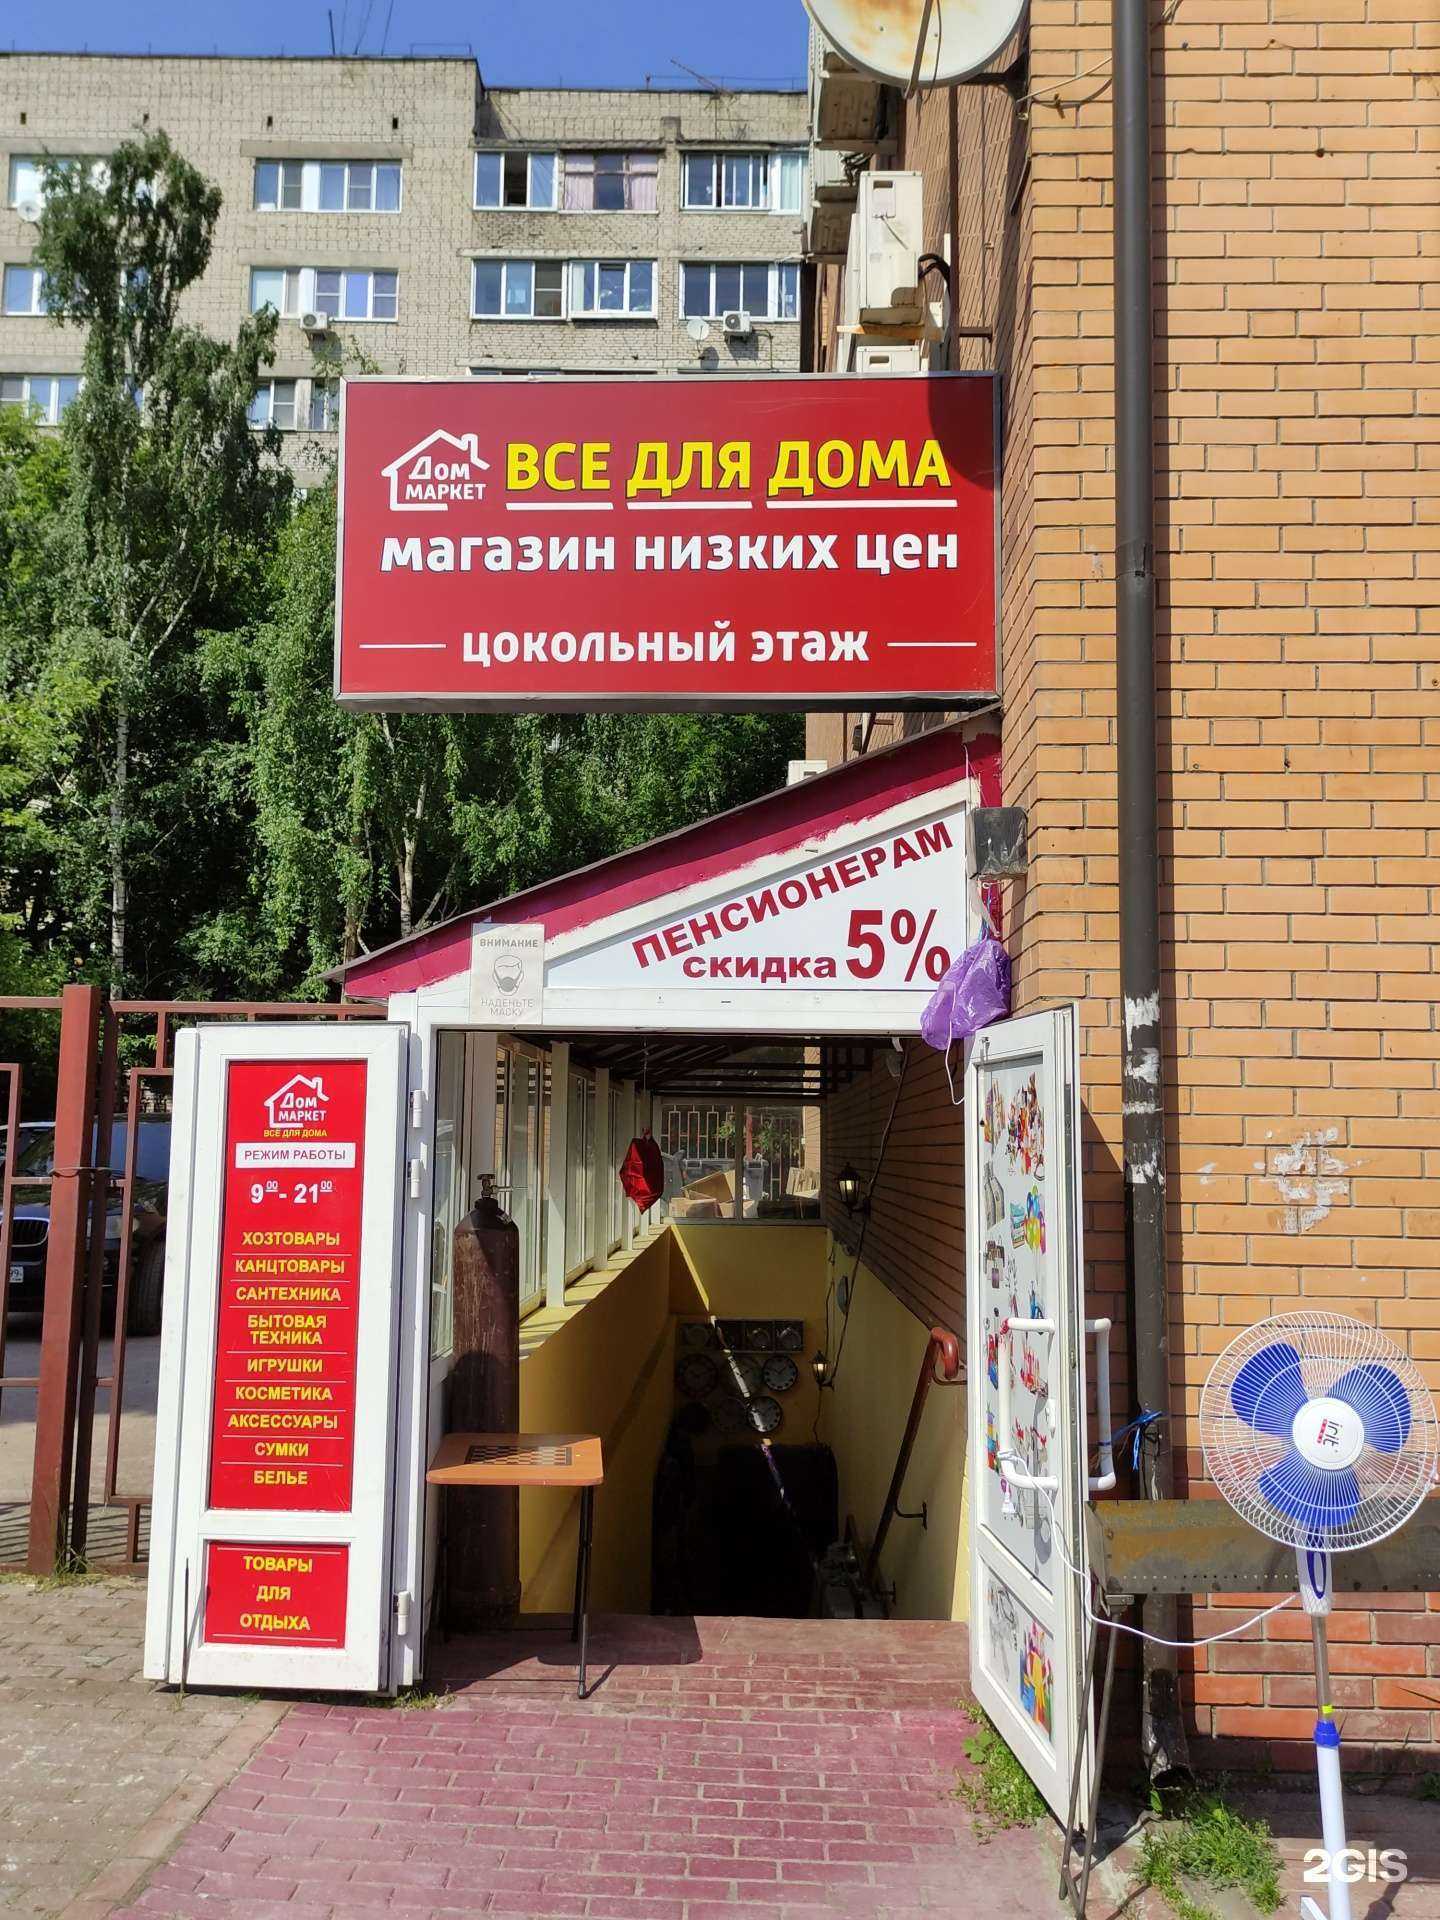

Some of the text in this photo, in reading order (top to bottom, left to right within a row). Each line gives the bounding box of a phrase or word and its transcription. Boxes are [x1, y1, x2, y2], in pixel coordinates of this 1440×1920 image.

[507, 439, 952, 498] ВСЕ ДЛЯ ДОМА
[405, 483, 487, 500] МАРКЕТ
[380, 533, 958, 575] магазин низких цен
[462, 620, 869, 667] цокольный этаж
[632, 821, 953, 967] ПЕНСИОНЕРАМ
[480, 938, 538, 948] ВНИМАНИЕ
[683, 908, 951, 983] скидка 5%
[481, 998, 534, 1008] НАДЕНЬТЕ
[490, 1007, 523, 1017] МАСКУ
[278, 1110, 326, 1122] МАРКЕТ
[282, 1129, 301, 1139] ДЛЯ
[302, 1129, 328, 1139] ДОМА
[244, 1149, 346, 1160] РЕЖИМ РАБОТЫ
[242, 1231, 340, 1246] ХОЗТОВАРЫ
[235, 1259, 345, 1275] КАНЦТОВАРЫ
[236, 1286, 342, 1301] САНТЕХНИКА
[247, 1314, 327, 1329] БЫТОВАЯ
[250, 1330, 323, 1345] ТЕХНИКА
[247, 1358, 323, 1373] ИГРУШКИ
[235, 1386, 333, 1401] КОСМЕТИКА
[227, 1414, 338, 1429] АКСЕССУАРЫ
[254, 1442, 309, 1457] СУМКИ
[253, 1470, 308, 1485] БЕЛЬЕ
[243, 1555, 313, 1573] ТОВАРЫ
[256, 1585, 291, 1603] ДЛЯ
[239, 1613, 311, 1632] ОТДЫХА
